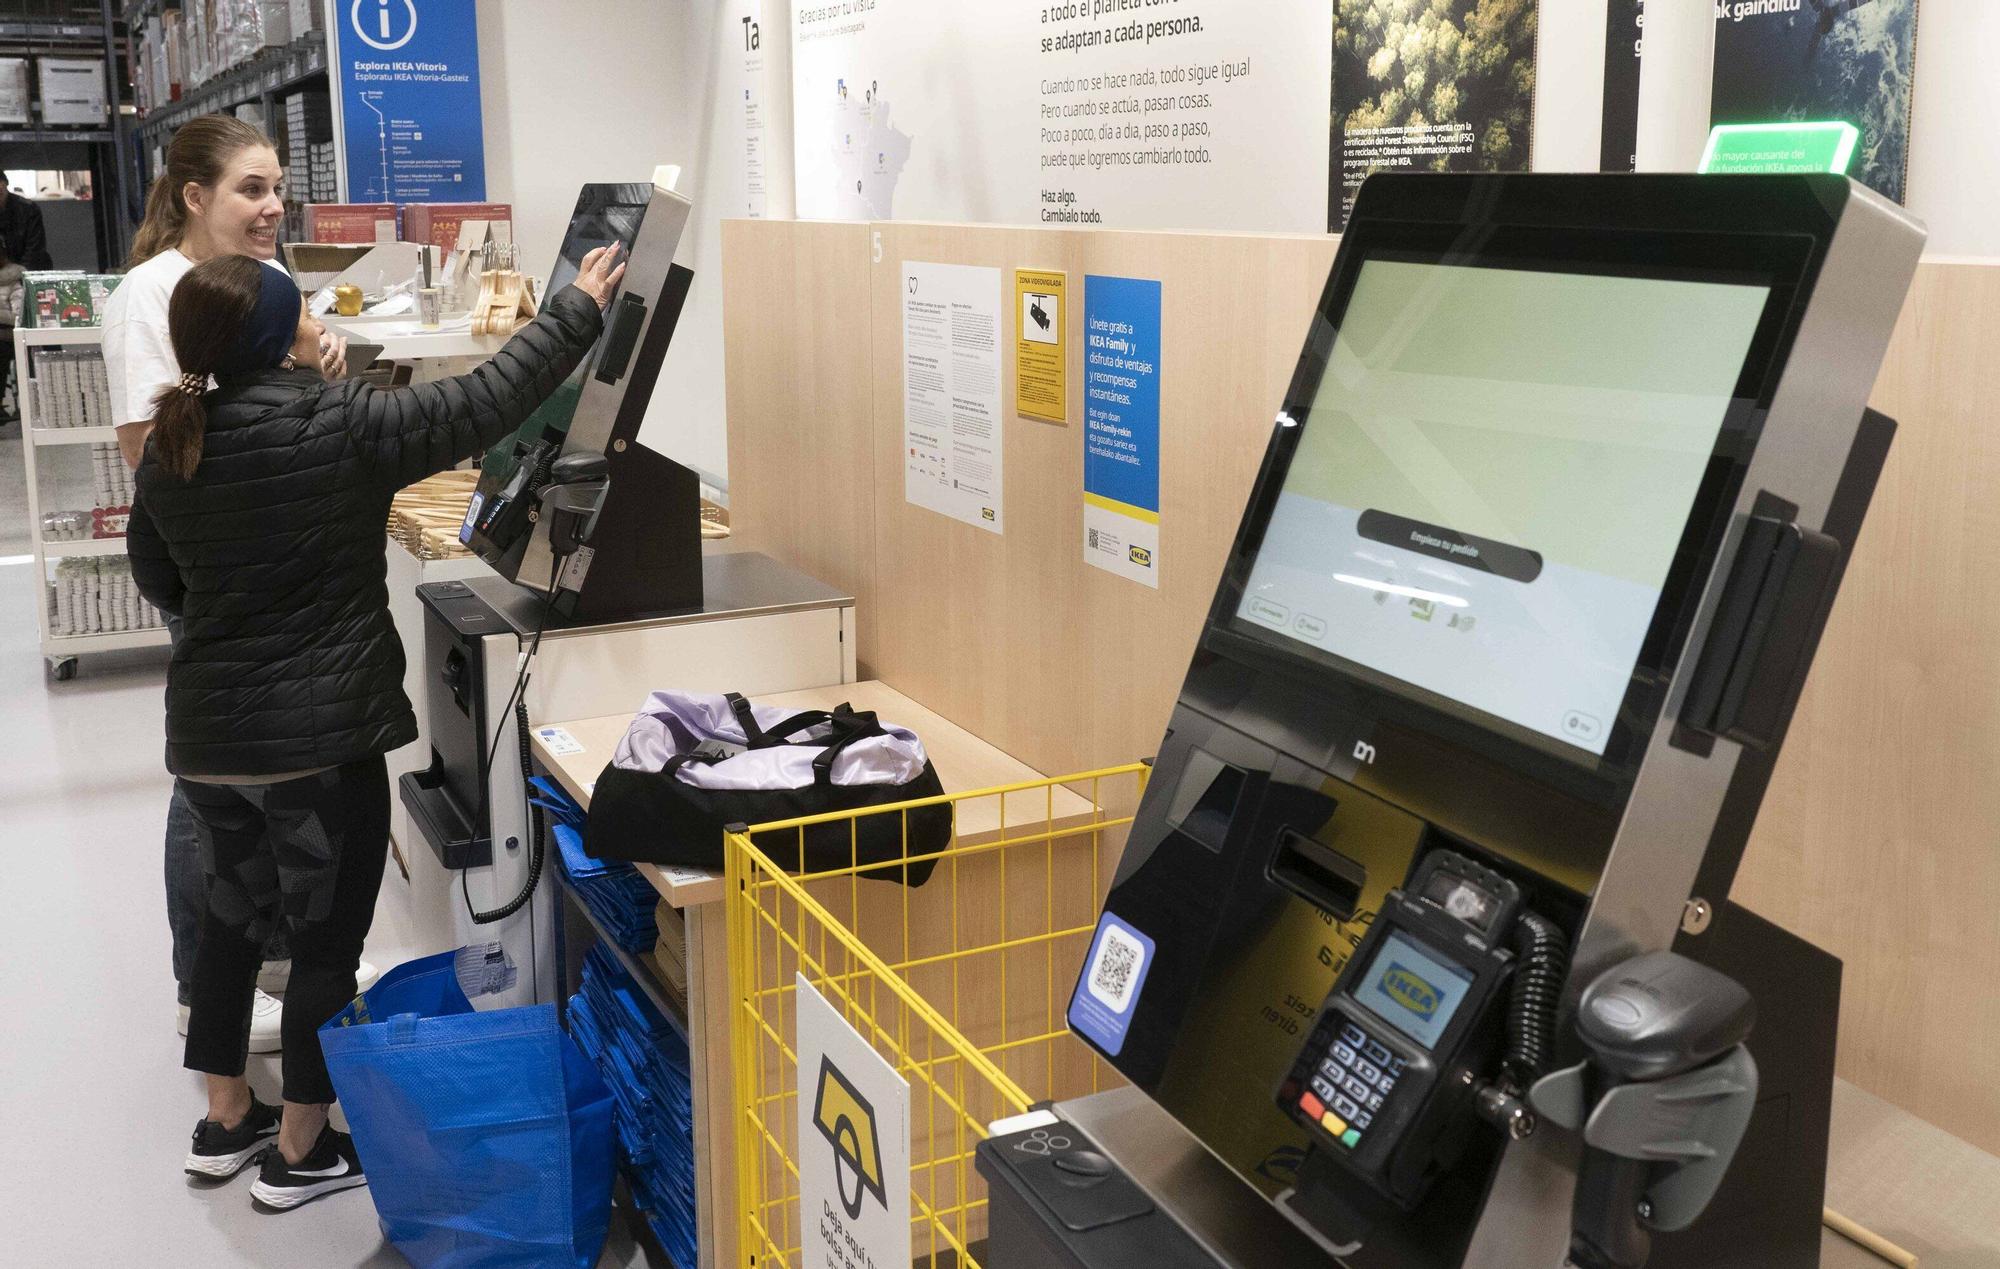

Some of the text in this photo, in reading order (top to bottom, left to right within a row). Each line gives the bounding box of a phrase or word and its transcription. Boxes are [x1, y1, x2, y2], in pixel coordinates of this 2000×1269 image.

[800, 0, 875, 24] Gracias por tu visita
[1041, 9, 1048, 24] a
[1050, 2, 1077, 22] todo
[1080, 0, 1090, 17] el
[1041, 14, 1204, 54] se adaptan a cada persona.
[354, 61, 448, 73] Explora IKEA Vitoria
[355, 72, 469, 82] Esploratu IKEA Vitoria-Gasteiz
[1041, 56, 1250, 95] Cuando no se hace nada, todo sigue igual
[1041, 93, 1212, 119] Pero cuando se actúa, pasan cosas.
[1041, 127, 1062, 143] Poco
[1064, 129, 1069, 142] a
[1115, 126, 1121, 139] a
[1144, 124, 1170, 143] paso
[1172, 123, 1178, 137] a
[1181, 120, 1211, 142] paso,
[1343, 132, 1475, 146] certificación del Forest Stewardship Council (FSC)
[1344, 122, 1472, 137] La madera de nuestros productos cuenta con la
[1041, 145, 1212, 171] puede que logremos cambiarlo todo.
[1413, 145, 1448, 155] información
[1448, 145, 1466, 153] sobre
[1466, 144, 1473, 153] el
[1343, 157, 1413, 169] programa forestal de IKEA.
[1041, 188, 1077, 206] Haz algo.
[1080, 208, 1103, 224] todo.
[873, 231, 883, 264] 5
[1019, 276, 1062, 287] ZONA VIDEOVIGILADA
[1089, 313, 1133, 335] Únete gratis a
[1089, 334, 1136, 356] IKEA Family y
[1089, 352, 1153, 376] disfruta de ventajas
[1089, 371, 1137, 389] y recompensas
[1089, 385, 1131, 405] instantáneas.
[1089, 420, 1101, 430] IKEA
[1131, 549, 1149, 562] IKEA
[1386, 972, 1434, 1011] IKEA
[824, 1198, 842, 1236] Deja
[820, 1218, 842, 1261] bolsa
